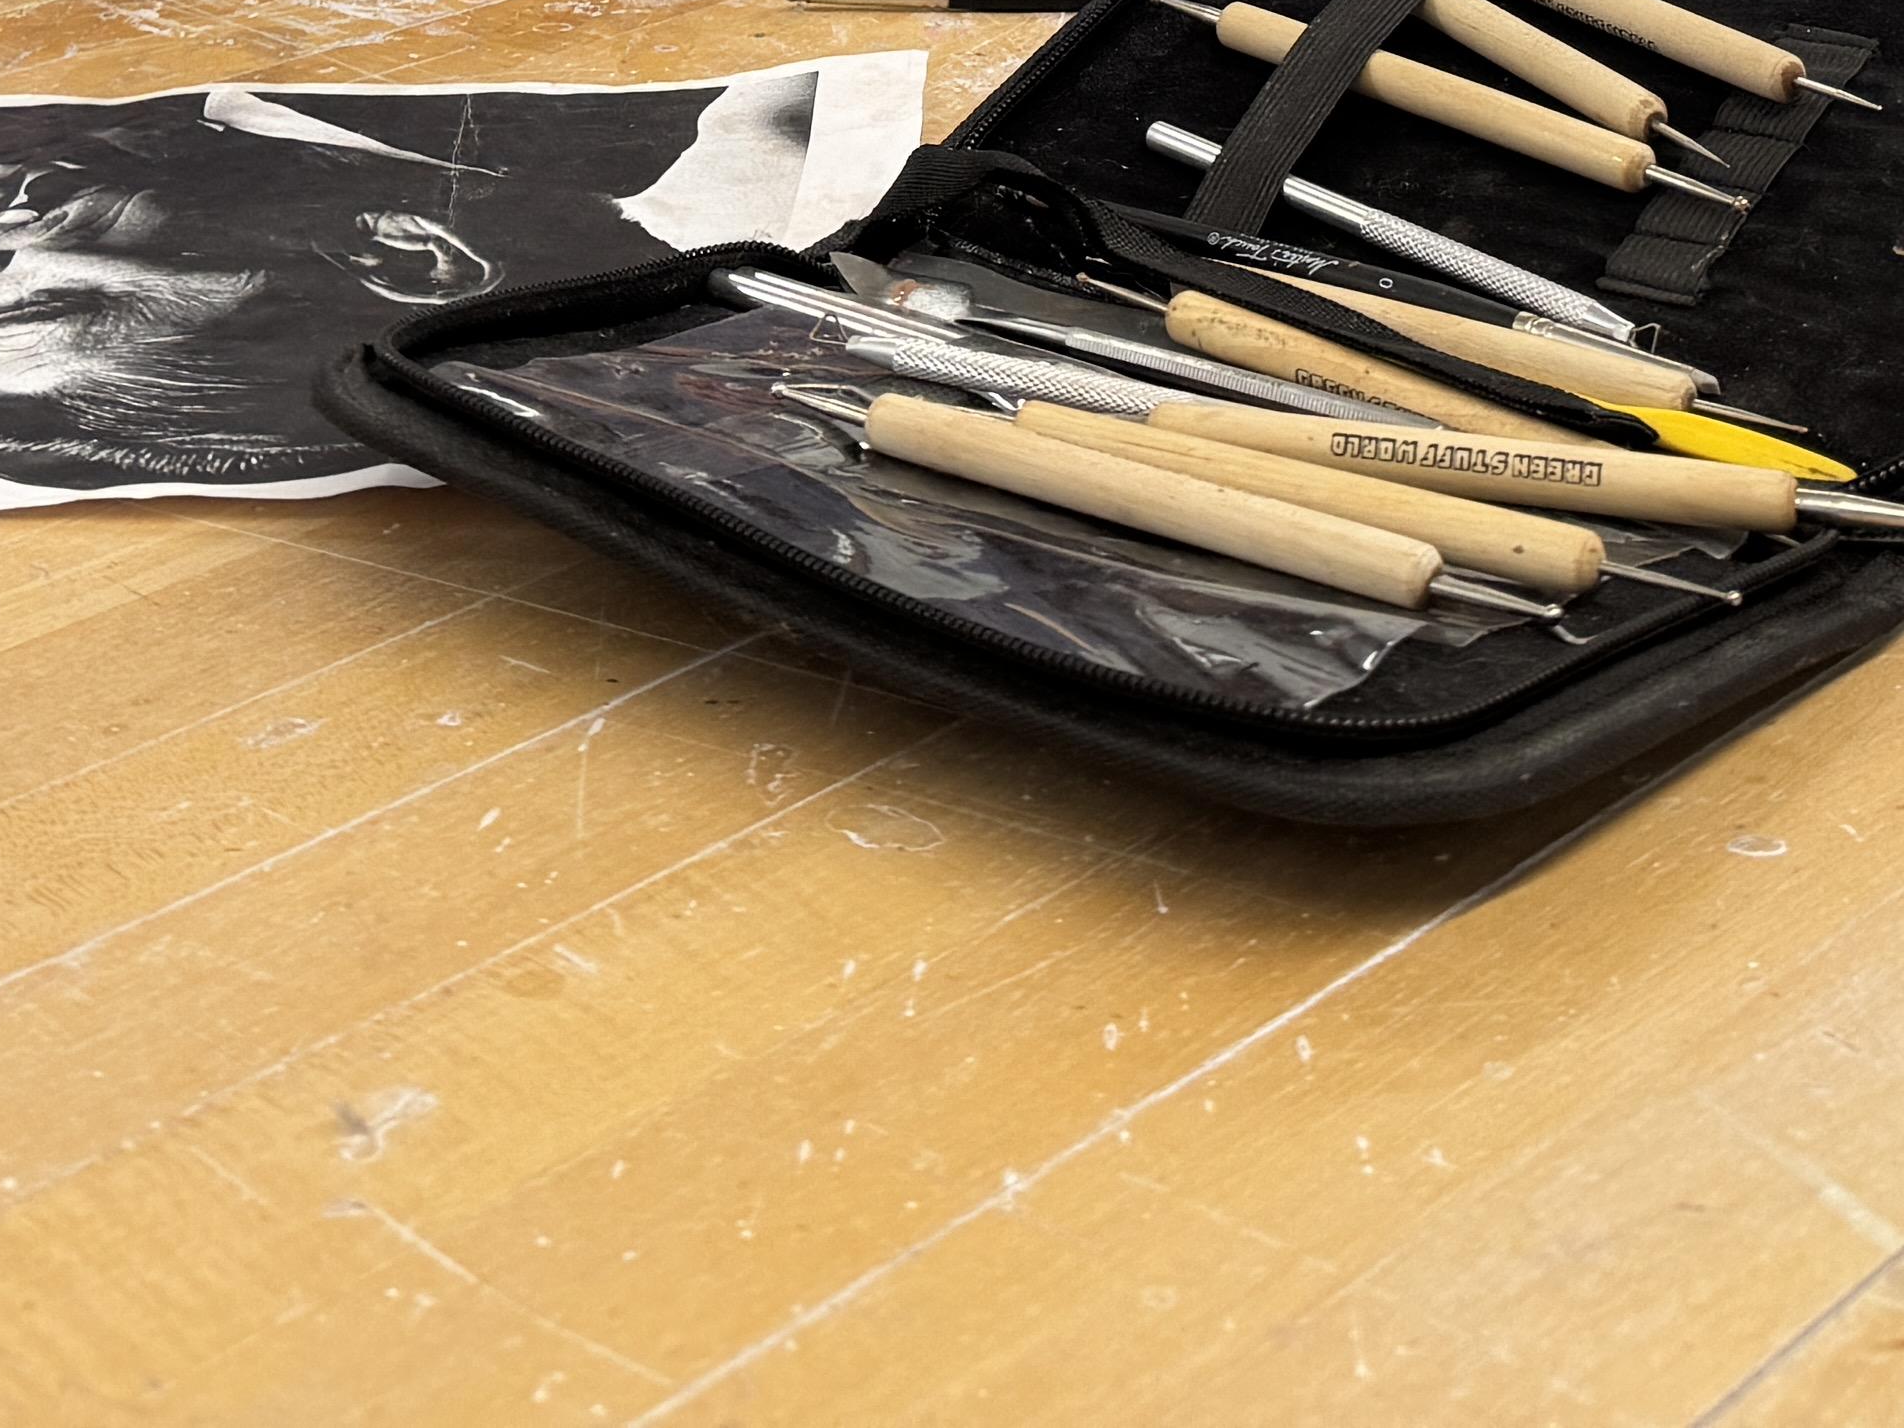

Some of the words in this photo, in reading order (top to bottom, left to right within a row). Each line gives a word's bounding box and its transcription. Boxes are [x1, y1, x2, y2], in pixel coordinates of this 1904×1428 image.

[1331, 431, 1418, 465] WORLD
[1419, 443, 1510, 477] STUFF
[1511, 452, 1604, 487] GREEN
